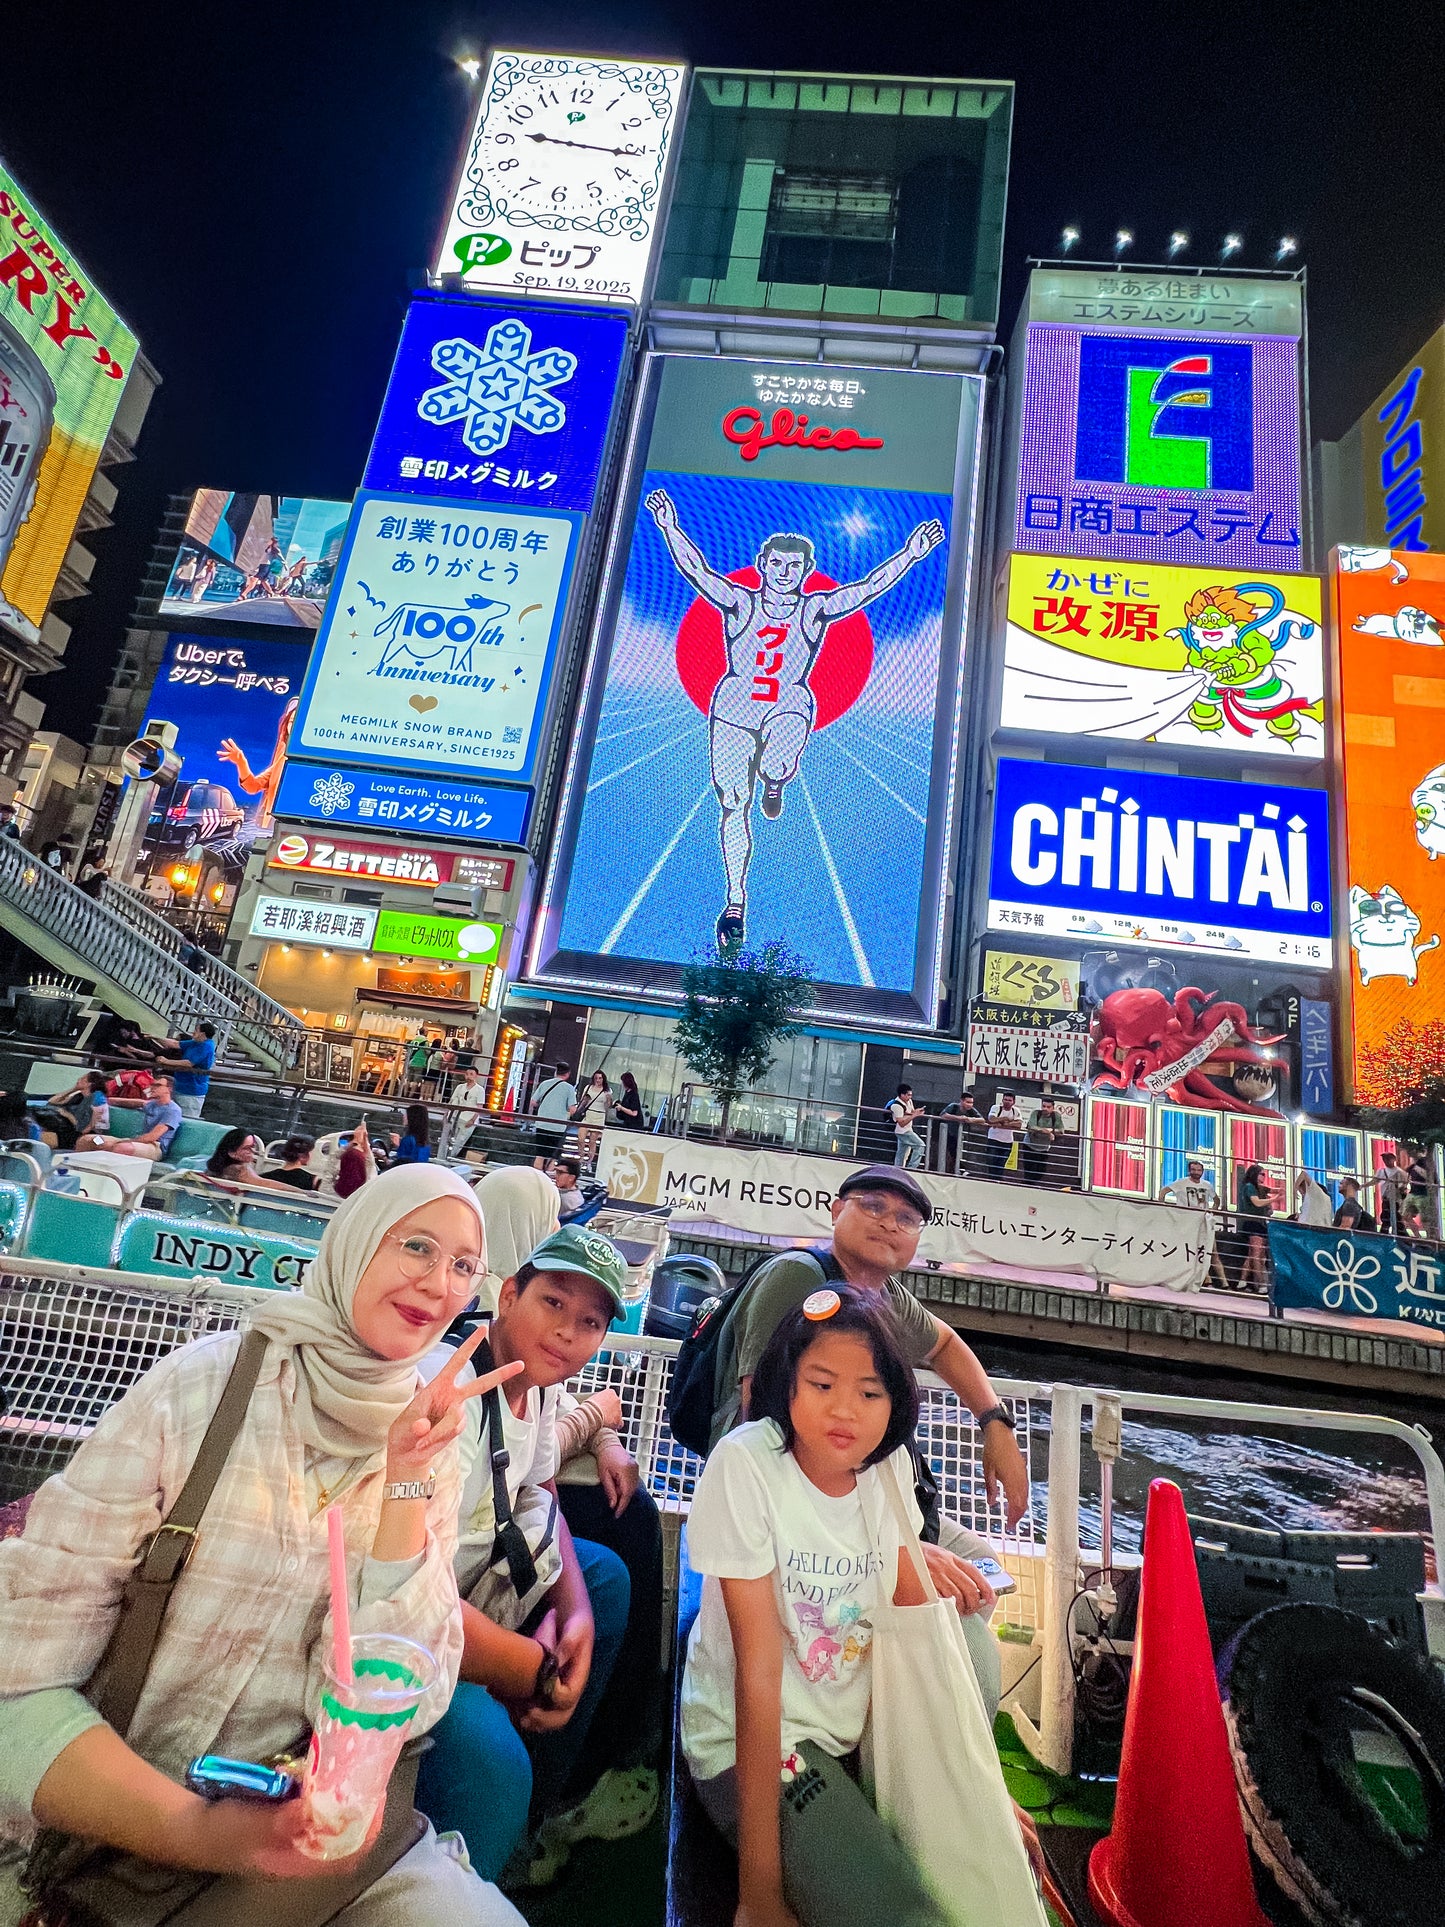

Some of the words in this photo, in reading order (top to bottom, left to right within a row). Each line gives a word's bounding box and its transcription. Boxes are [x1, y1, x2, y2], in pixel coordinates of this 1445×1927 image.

[537, 90, 560, 108] 11
[570, 88, 594, 104] 12
[605, 98, 620, 112] 1
[507, 104, 534, 126] 10
[620, 117, 642, 131] 2
[495, 132, 515, 145] 9
[624, 143, 646, 156] 3
[498, 158, 520, 171] 8
[613, 166, 632, 181] 4
[519, 176, 541, 191] 7
[551, 185, 568, 202] 6
[586, 181, 603, 198] 5
[0, 190, 87, 306] SUPER
[520, 240, 602, 269] ピップ
[513, 271, 551, 288] Sep.
[557, 276, 578, 290] 19,
[584, 279, 631, 294] 2025
[1099, 278, 1231, 301] 夢ある住まい
[1073, 303, 1255, 328] エステムシリーズ
[753, 374, 866, 395] すこやかな毎日、
[760, 389, 854, 408] ゆたかな人生
[400, 456, 558, 491] 雪印メグミルク
[1024, 493, 1301, 547] 日商エステム
[377, 515, 549, 555] 創業100周年
[391, 551, 520, 585] ありがとう
[1045, 568, 1150, 598] かぜに
[402, 609, 505, 646] 100th
[1032, 596, 1162, 642] 改源
[751, 623, 791, 702] グリコ
[168, 665, 290, 694] タクシー呼べる
[367, 661, 496, 692] Anniversary
[313, 727, 345, 740] 100th
[341, 714, 399, 729] MEGMILK
[404, 721, 443, 735] SNOW
[447, 727, 493, 740] BRAND
[370, 782, 396, 795] Love
[398, 785, 432, 797] Earth.
[436, 789, 461, 802] Love
[464, 792, 488, 805] Life.
[357, 796, 493, 830] 雪印メグミルク
[311, 844, 440, 882] ZETTERIA
[998, 909, 1045, 927] 天気予報
[1113, 919, 1133, 929] 12時
[1206, 930, 1226, 939] 24時
[1278, 941, 1322, 958] 21:16
[1002, 961, 1060, 1000] くくる
[972, 1006, 1055, 1026] 大阪もんを食す
[1072, 1023, 1087, 1032] 2F
[974, 1033, 1071, 1073] 大阪に乾杯
[665, 1170, 731, 1198] MGM
[740, 1180, 837, 1212] RESOR
[663, 1196, 706, 1212] JAPAN
[152, 1233, 264, 1279] INDY
[574, 1235, 603, 1251] Hard
[601, 1245, 621, 1269] Rock
[1392, 1247, 1445, 1301] 近
[787, 1549, 852, 1577] HELLO
[782, 1575, 824, 1604] AND
